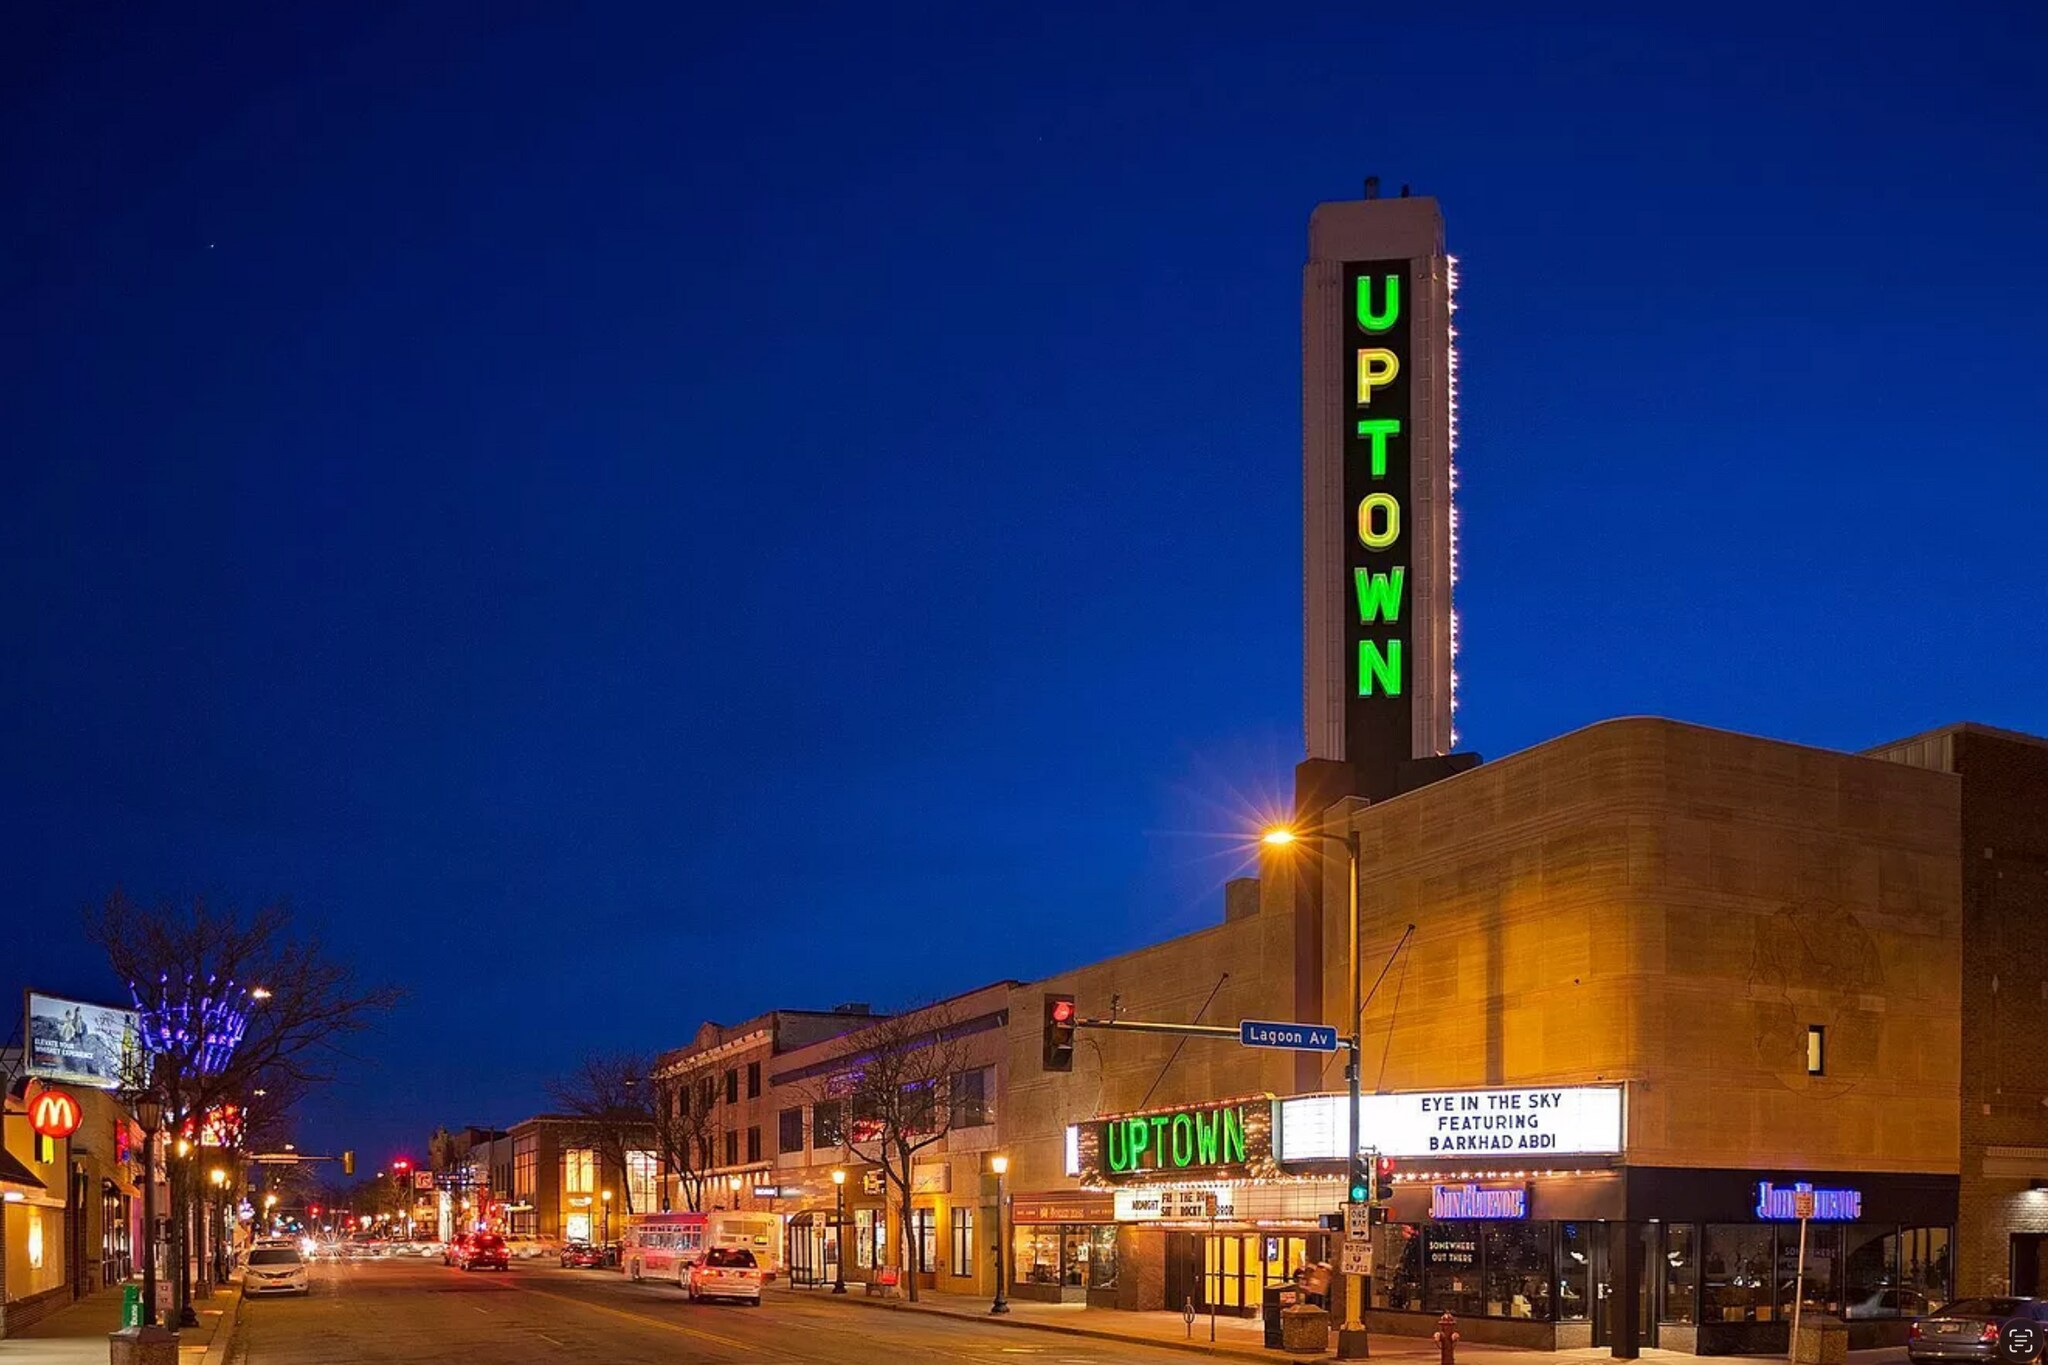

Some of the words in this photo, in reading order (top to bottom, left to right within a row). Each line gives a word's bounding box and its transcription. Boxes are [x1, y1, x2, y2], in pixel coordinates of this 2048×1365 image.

[1354, 275, 1404, 698] UPTOWN
[1250, 1027, 1302, 1045] Lagoon
[1309, 1031, 1328, 1045] Av
[1422, 1097, 1454, 1111] EYE
[1461, 1096, 1478, 1110] IN
[1488, 1095, 1521, 1109] THE
[1529, 1093, 1561, 1108] SKY
[1438, 1115, 1538, 1131] FEATURING
[1109, 1106, 1245, 1172] UPTOWN
[1429, 1134, 1513, 1150] BARKHAD
[1518, 1134, 1555, 1149] ABDI
[1179, 1192, 1193, 1203] THE
[1180, 1205, 1202, 1217] ROCKY
[1351, 1209, 1366, 1219] ONE
[1351, 1220, 1366, 1228] WAY
[1344, 1244, 1354, 1252] NO
[1355, 1245, 1371, 1253] TURN
[1429, 1241, 1475, 1251] SOMEWHERE
[1432, 1253, 1447, 1262] OUT
[1449, 1254, 1473, 1263] THERE
